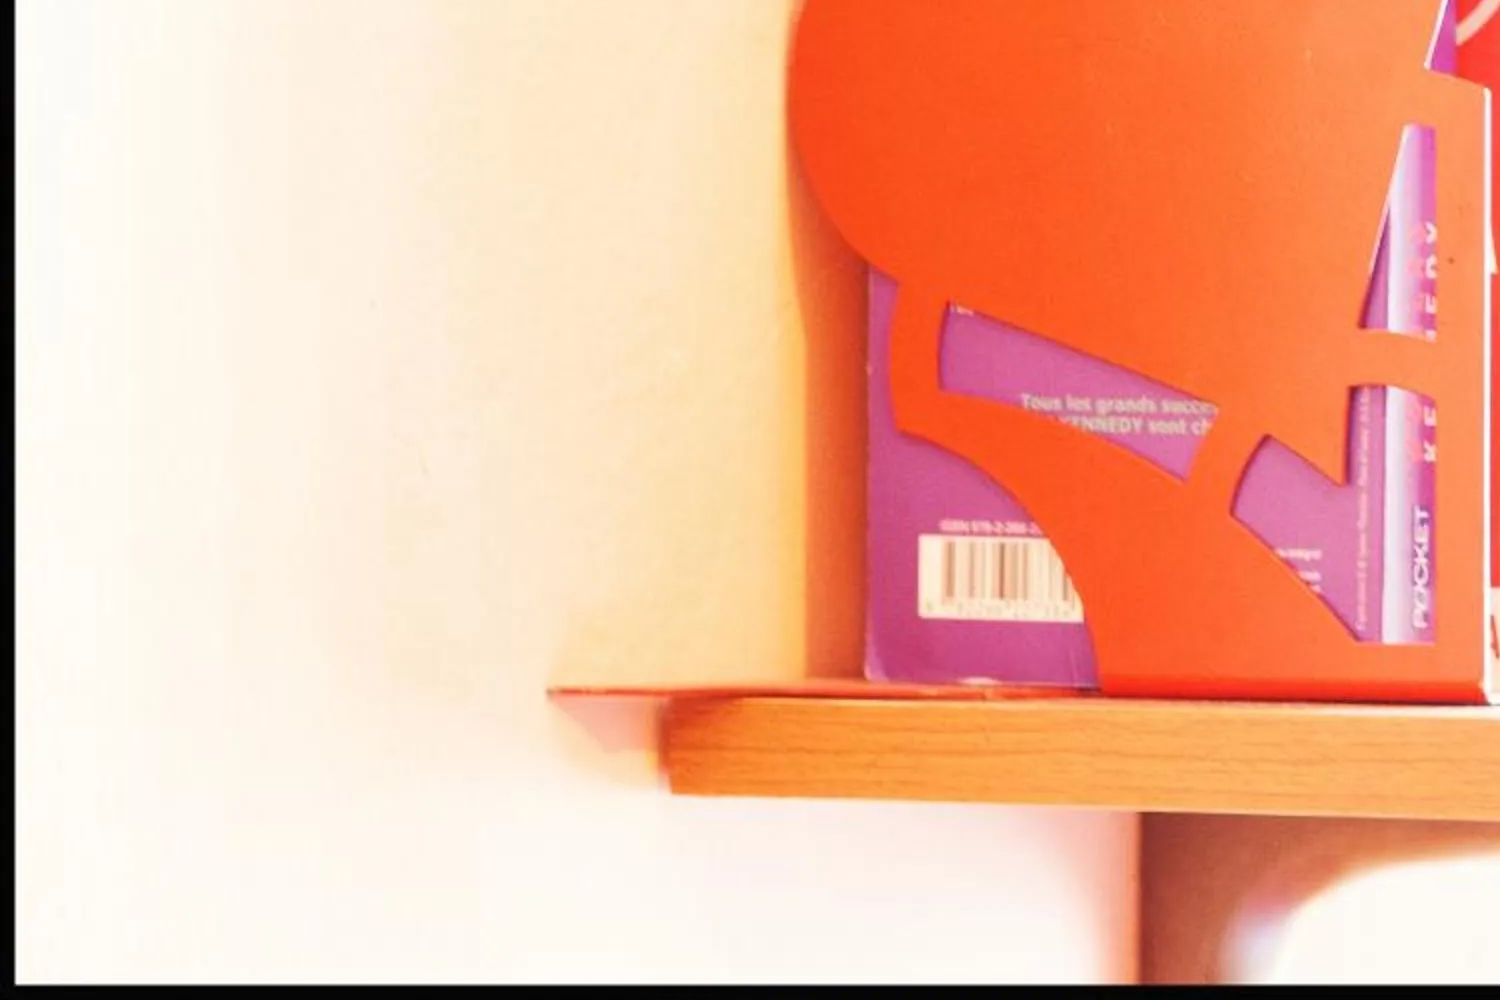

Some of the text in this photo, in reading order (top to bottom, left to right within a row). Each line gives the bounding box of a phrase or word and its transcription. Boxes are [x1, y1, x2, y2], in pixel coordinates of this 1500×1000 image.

[1021, 393, 1063, 411] Tous
[1066, 393, 1093, 412] les
[1095, 395, 1157, 416] grands
[1149, 418, 1185, 435] sont
[1411, 504, 1430, 629] POCKET
